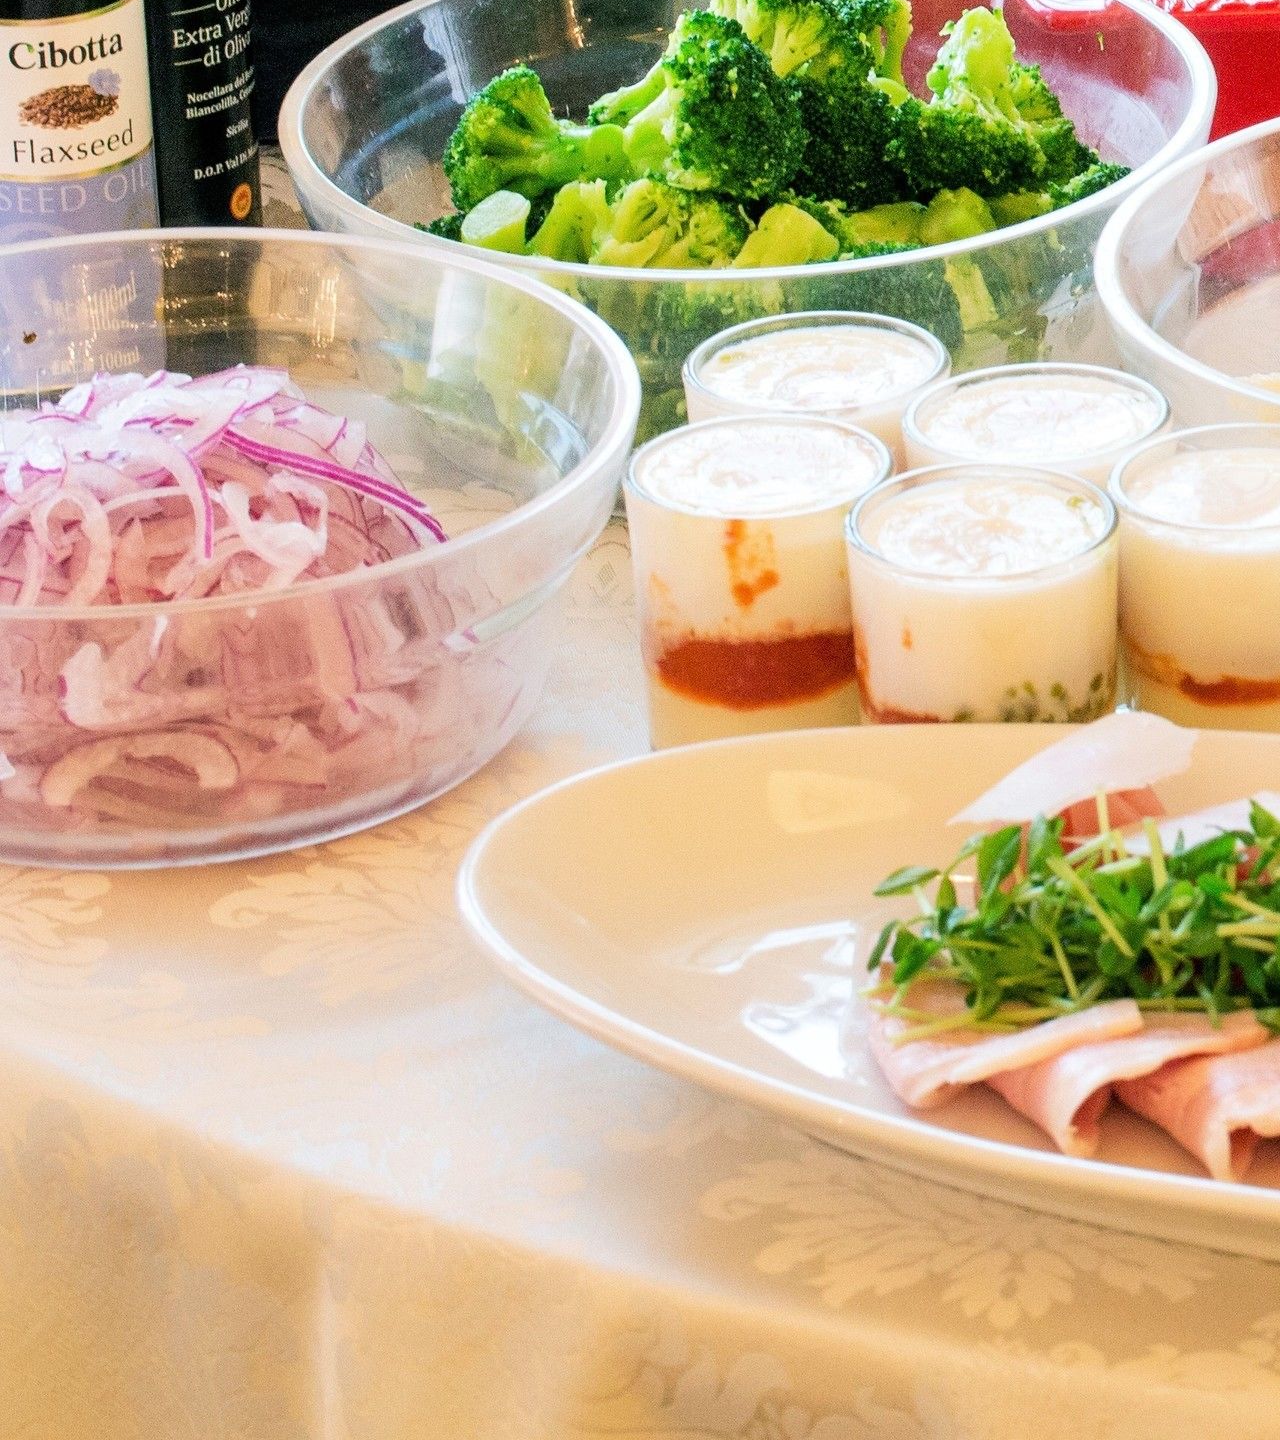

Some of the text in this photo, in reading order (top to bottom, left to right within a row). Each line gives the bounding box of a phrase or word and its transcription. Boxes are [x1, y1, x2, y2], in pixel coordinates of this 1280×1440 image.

[9, 32, 123, 70] Cibotta
[172, 24, 222, 49] Extra
[203, 45, 221, 67] di
[13, 119, 134, 164] Flaxseed
